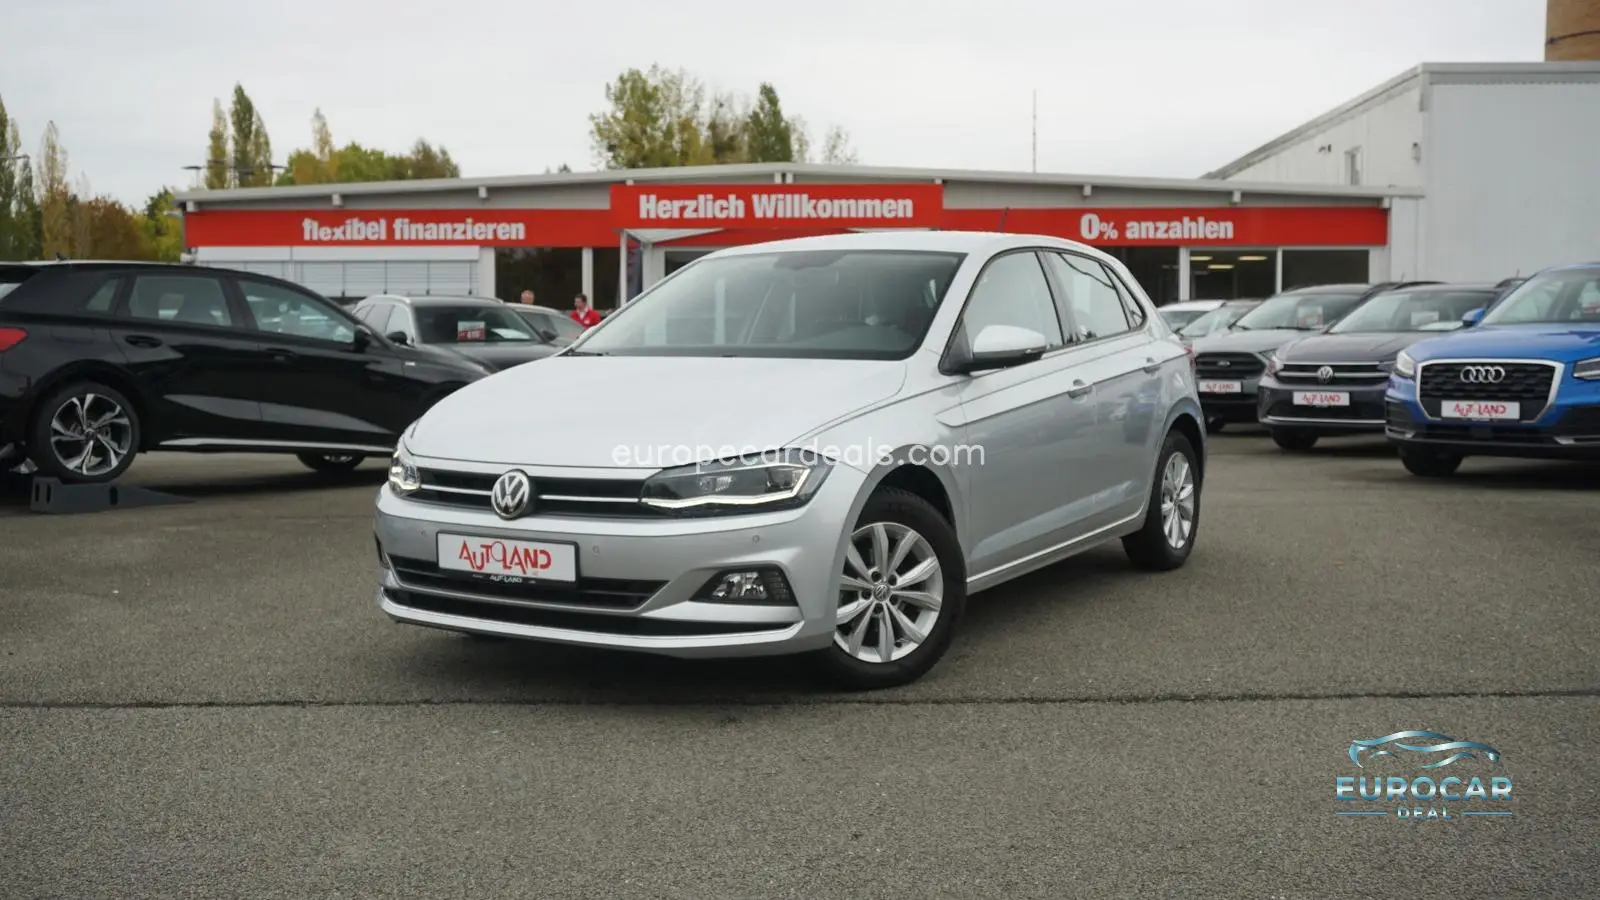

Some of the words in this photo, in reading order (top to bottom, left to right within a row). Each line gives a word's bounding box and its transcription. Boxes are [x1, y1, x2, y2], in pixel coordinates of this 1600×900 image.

[639, 193, 745, 219] Herzlich
[752, 193, 913, 219] Willkommen
[302, 217, 387, 241] flexibel
[393, 217, 525, 241] finanzieren
[1080, 213, 1118, 241] 0%
[1125, 217, 1234, 240] anzahlen
[1204, 383, 1236, 392] AUTLAND
[1302, 392, 1341, 404] AUTLAND
[459, 540, 552, 575] AUTOLAND
[489, 575, 523, 583] AUTLAND
